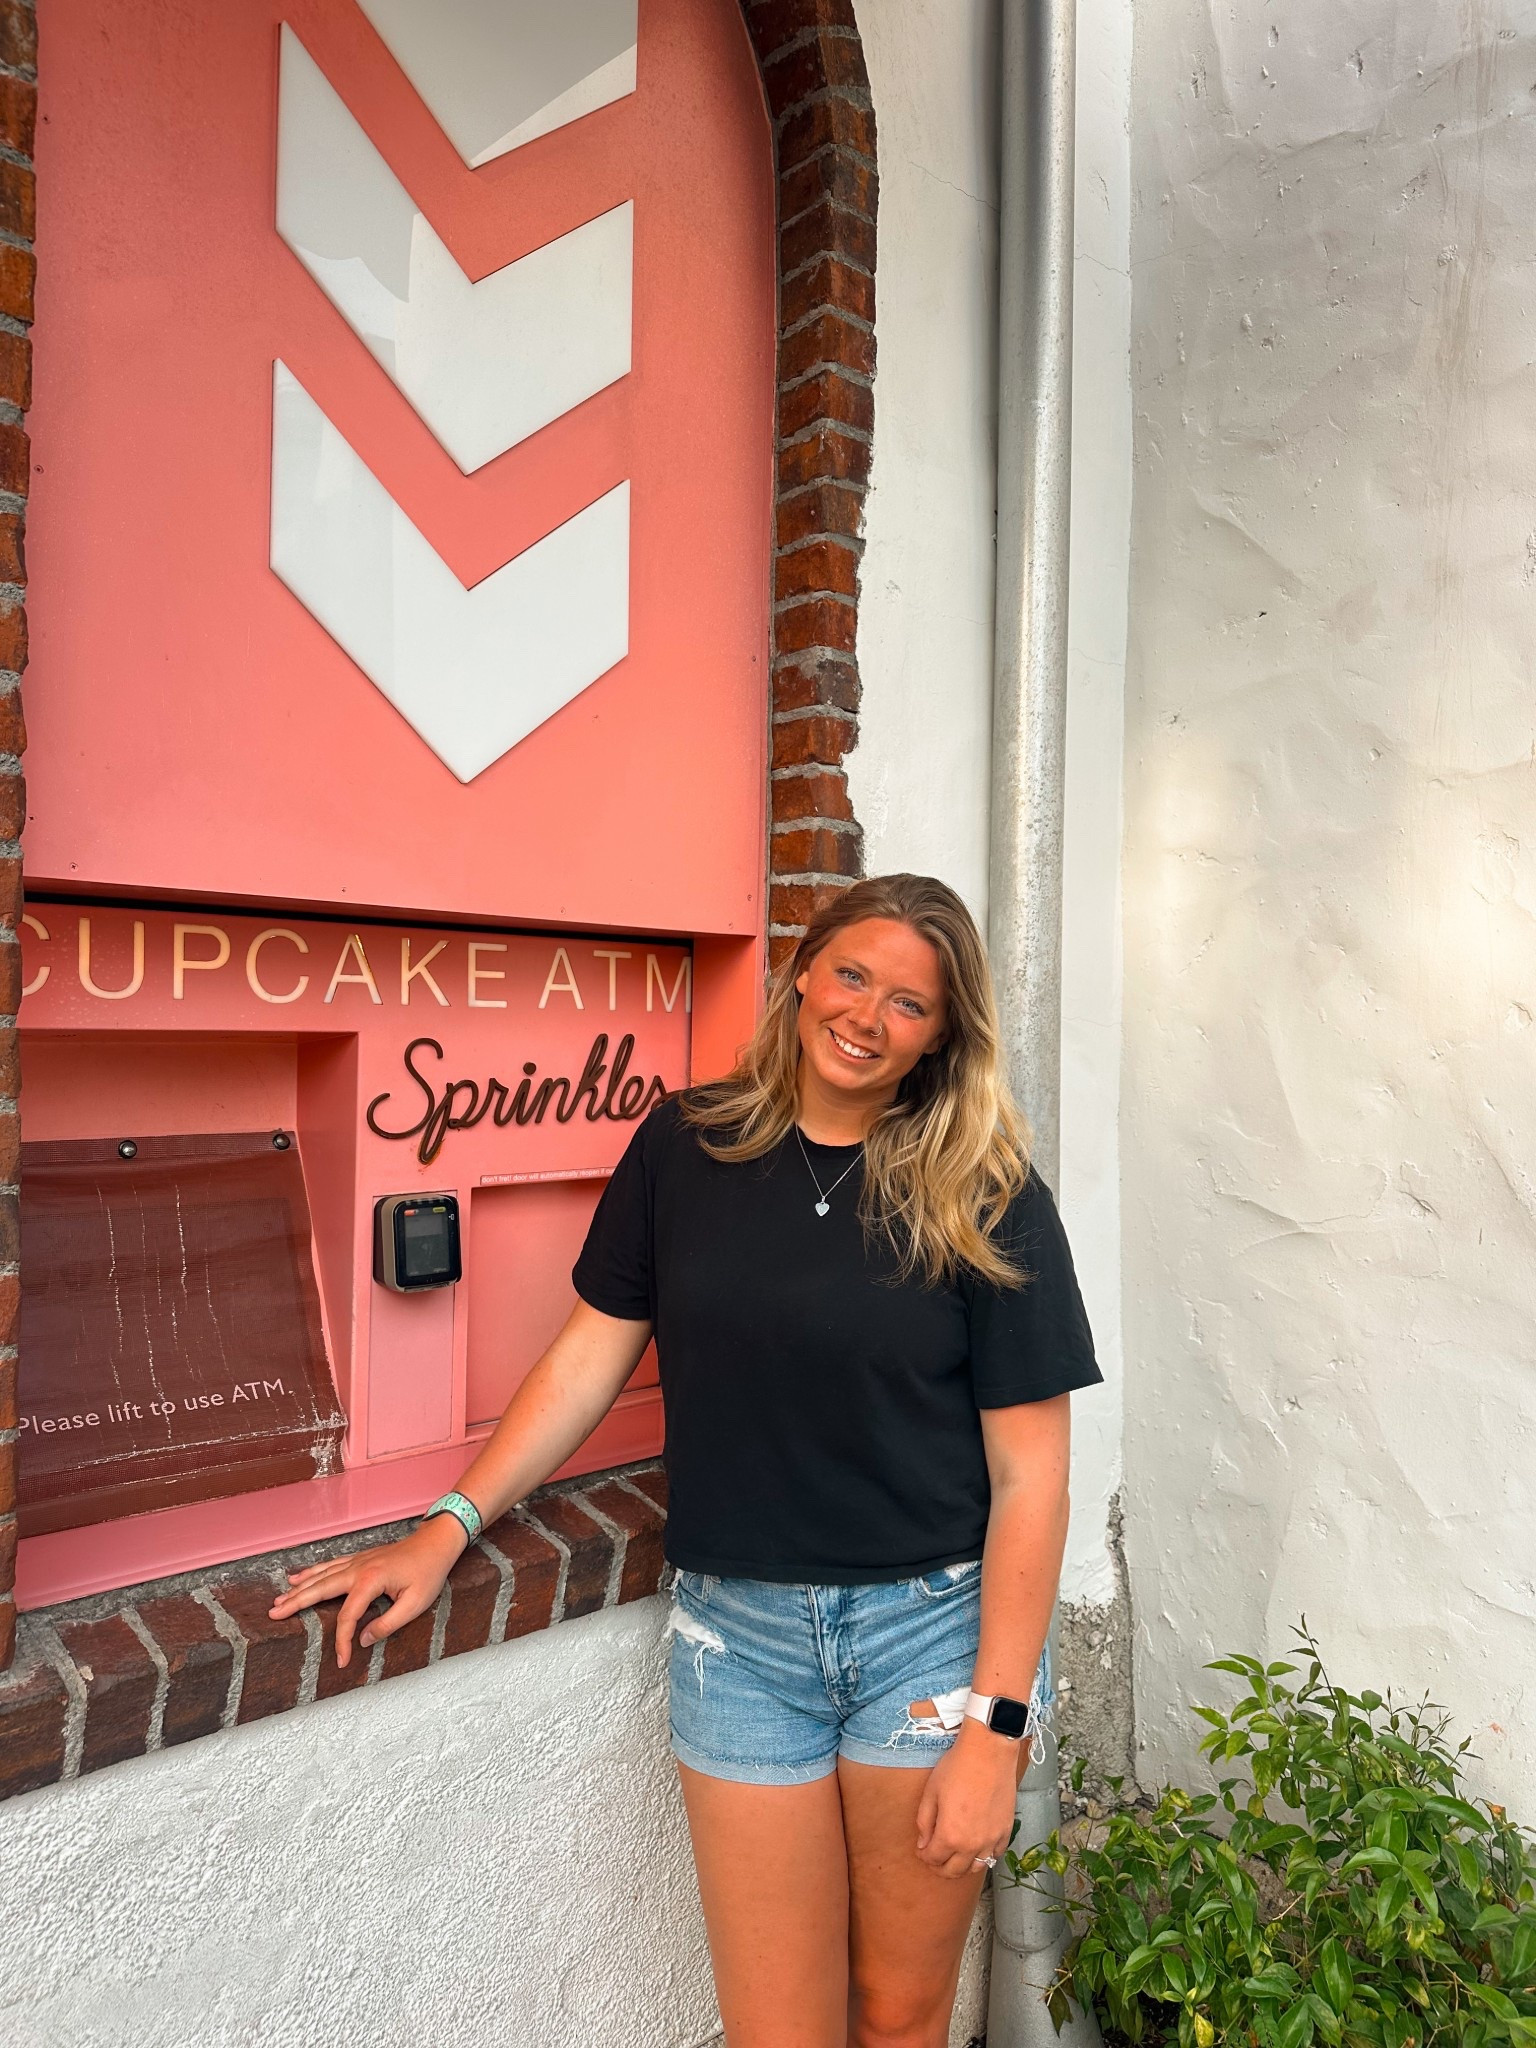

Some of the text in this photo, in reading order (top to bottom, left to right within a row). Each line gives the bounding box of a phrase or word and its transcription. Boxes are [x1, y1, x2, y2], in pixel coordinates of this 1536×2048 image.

[538, 947, 691, 1013] ATM
[366, 1033, 688, 1165] Sprinkles
[513, 1174, 528, 1182] door
[529, 1173, 539, 1181] will
[540, 1170, 579, 1180] automatically
[580, 1169, 600, 1178] reopen
[18, 1411, 100, 1437] Please
[107, 1401, 144, 1423] lift
[149, 1401, 176, 1416] to
[183, 1393, 225, 1411] use
